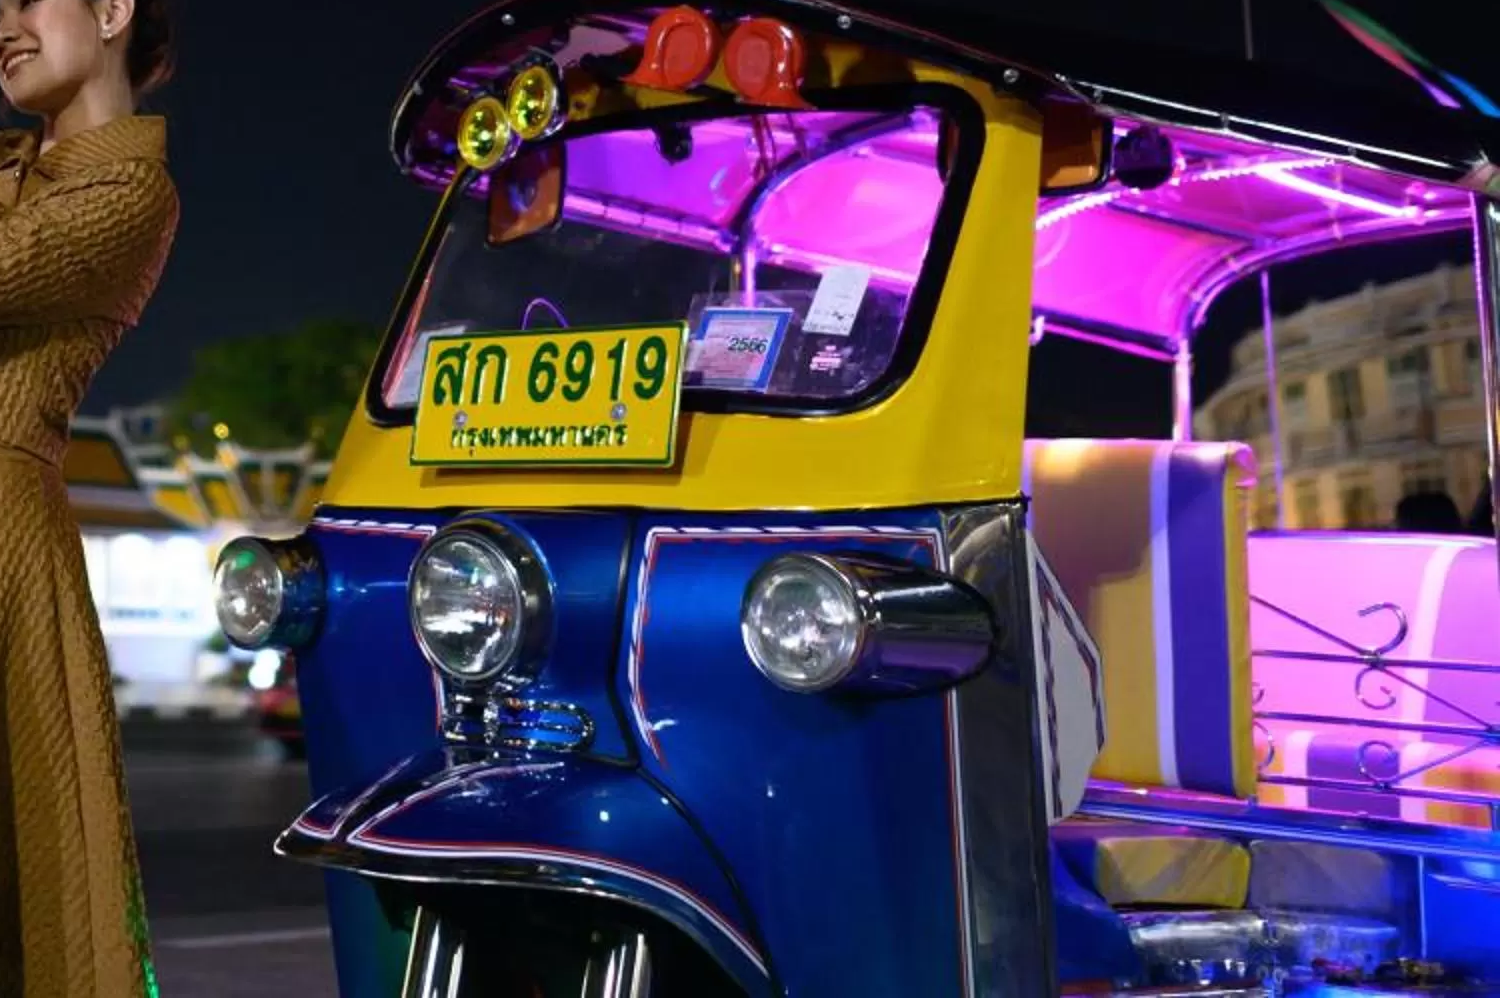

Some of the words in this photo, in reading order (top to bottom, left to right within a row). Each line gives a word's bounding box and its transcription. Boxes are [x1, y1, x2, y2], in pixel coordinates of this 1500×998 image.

[727, 336, 769, 354] 2566
[433, 341, 507, 406] สก
[527, 335, 668, 403] 6919
[451, 424, 628, 457] กรุงเทพมหานคร
